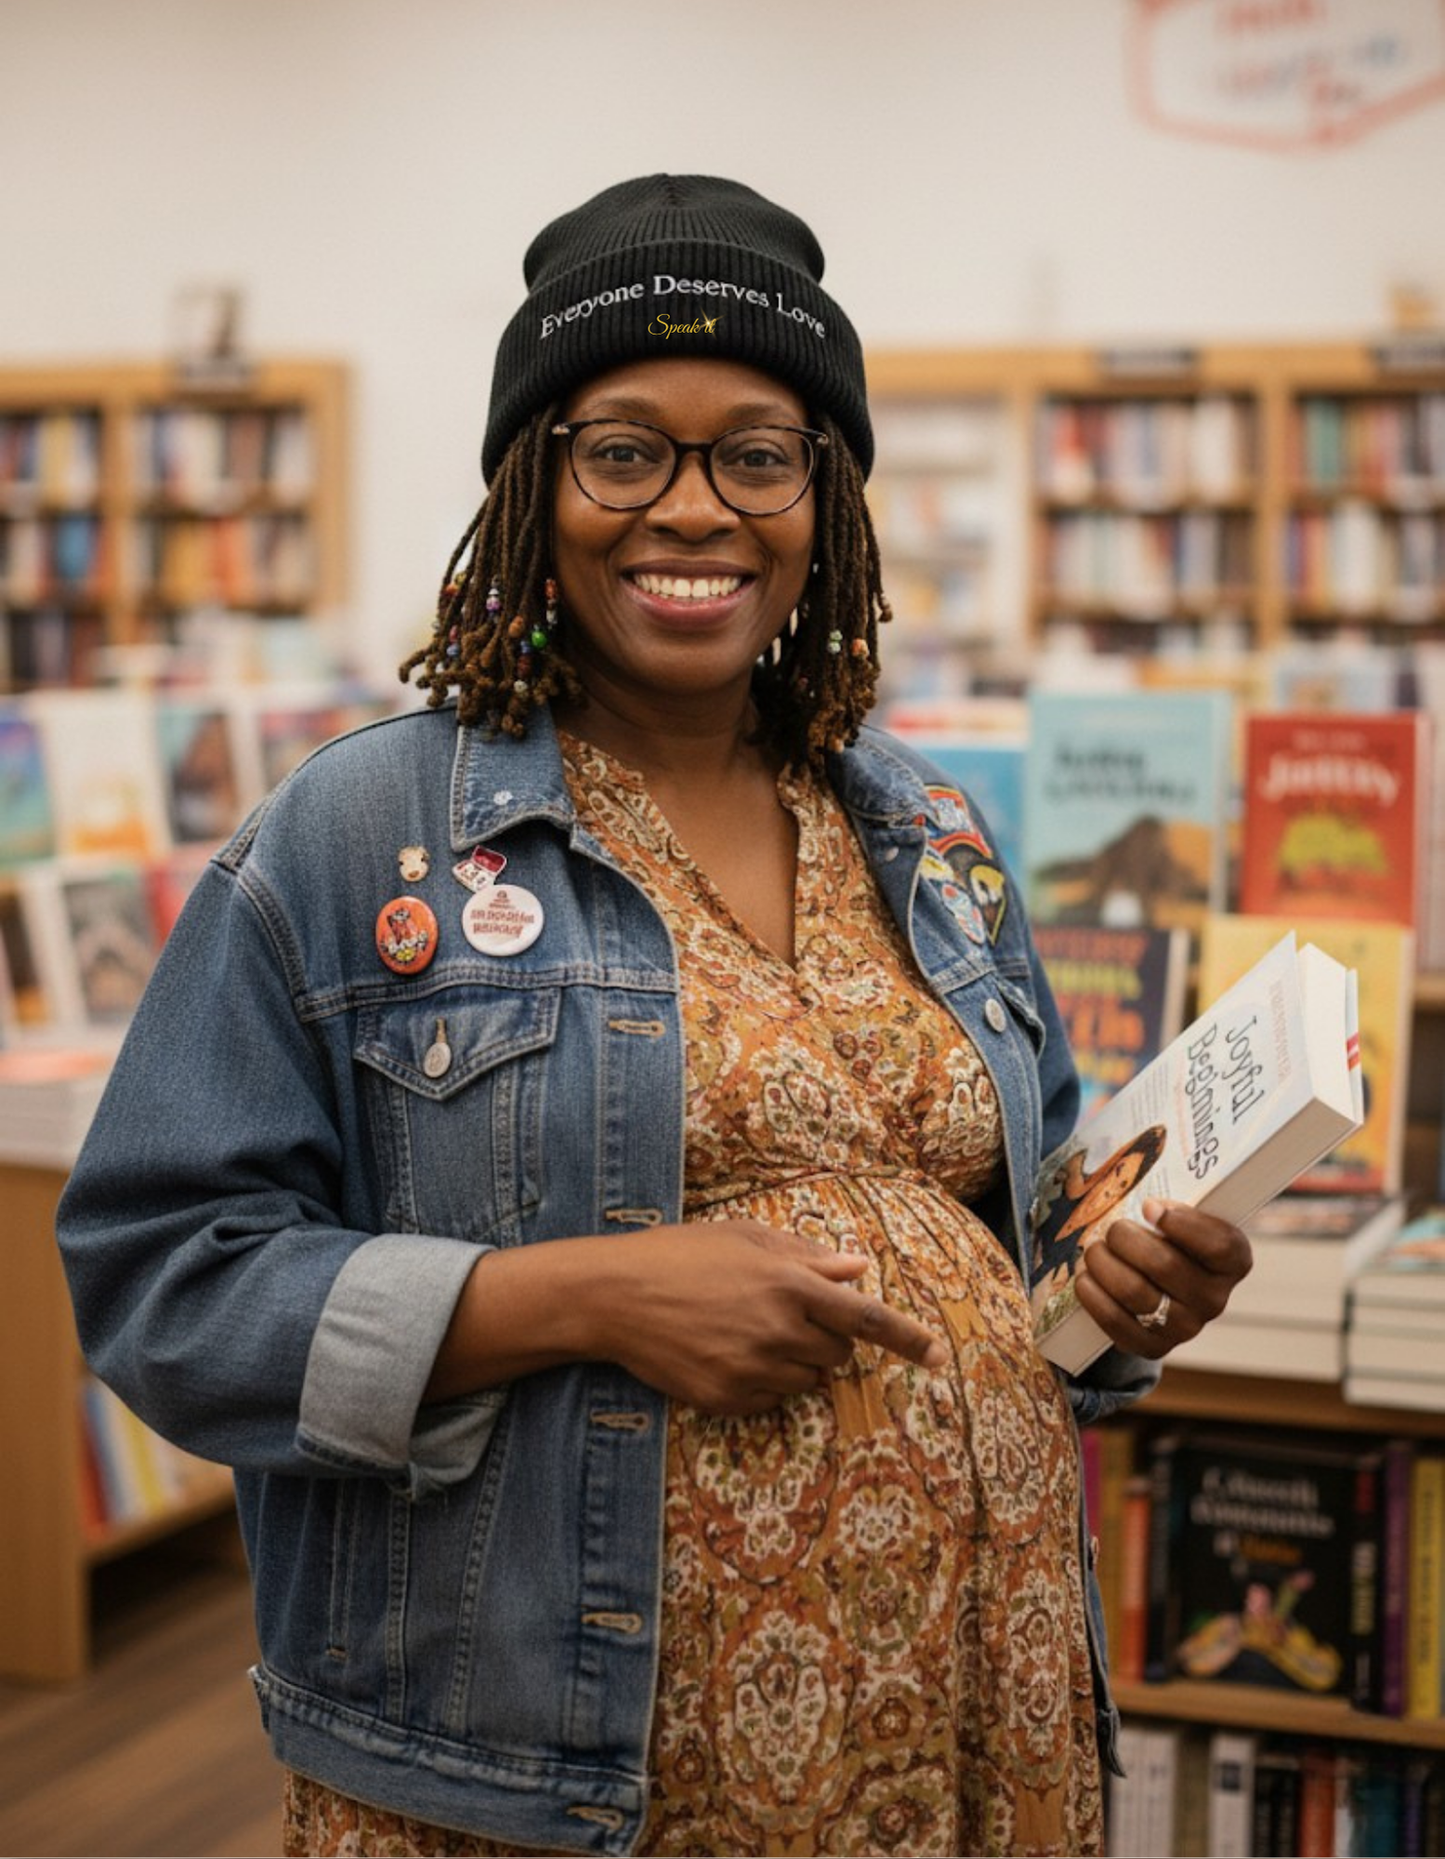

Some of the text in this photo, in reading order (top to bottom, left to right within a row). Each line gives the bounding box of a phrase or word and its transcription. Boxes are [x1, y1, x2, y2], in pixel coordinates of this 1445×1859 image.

[540, 275, 826, 339] Everyone Deserves Love
[647, 313, 700, 340] Speak
[1221, 1015, 1266, 1126] Joyful
